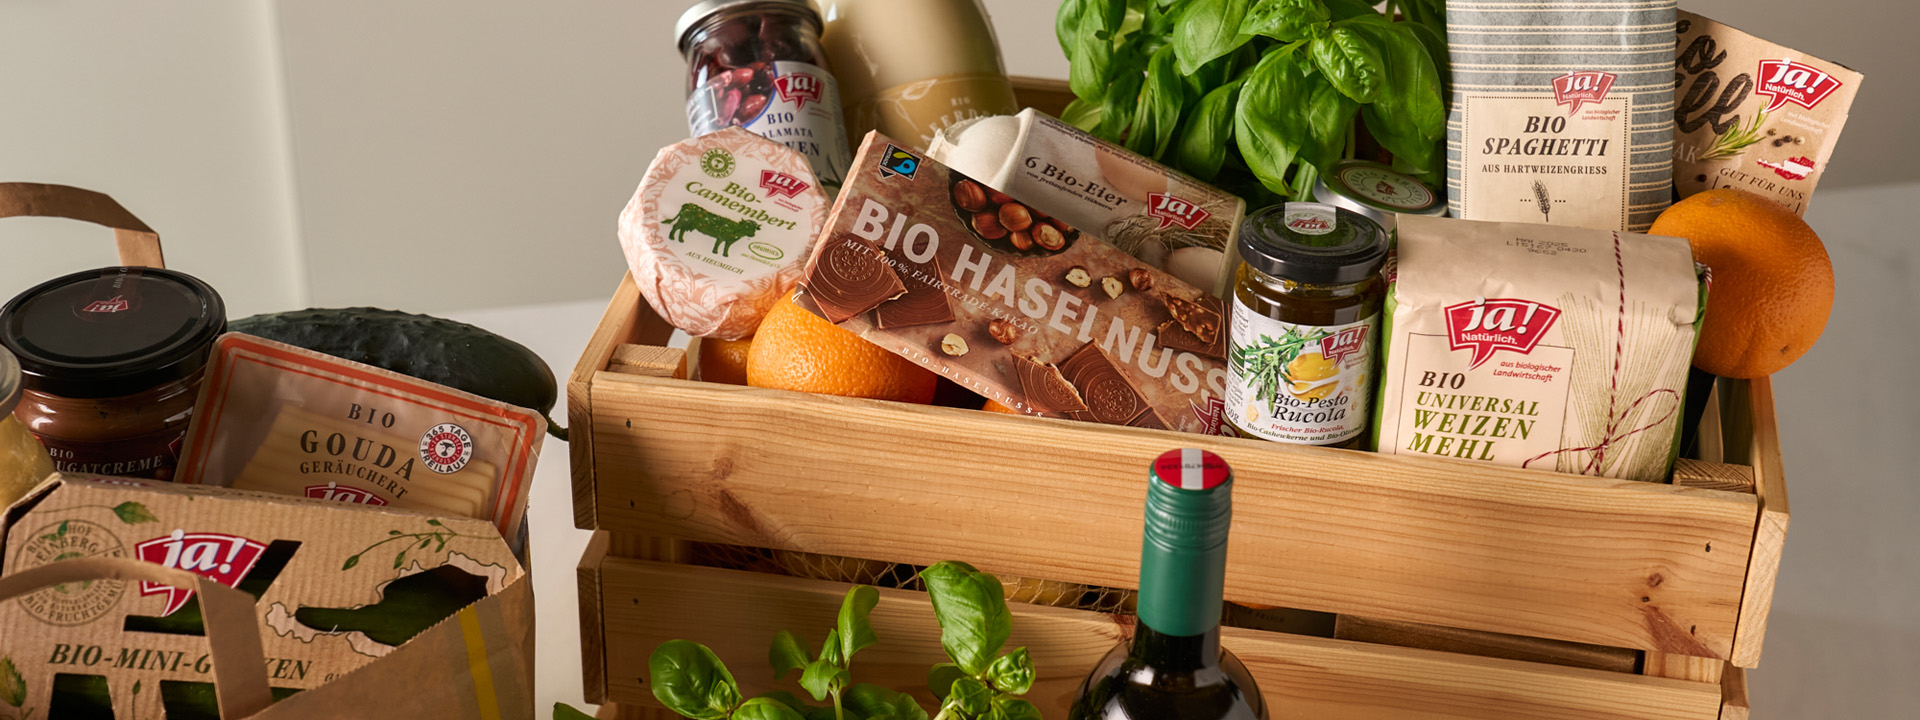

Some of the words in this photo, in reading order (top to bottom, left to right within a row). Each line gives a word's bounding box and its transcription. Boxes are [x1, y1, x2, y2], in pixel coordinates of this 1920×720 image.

[786, 72, 816, 92] ja!
[1563, 70, 1605, 93] ja!
[1767, 57, 1828, 94] ja!
[1765, 83, 1805, 101] Natürlich.
[767, 112, 794, 125] BIO
[1523, 115, 1567, 134] BIO
[762, 127, 813, 139] ALAMATA
[785, 141, 820, 156] VEN
[1482, 137, 1609, 157] SPAGHETTI
[767, 170, 802, 190] ja!
[1482, 164, 1500, 173] AUS
[1504, 165, 1607, 175] HARTWEIZENGRIESS
[722, 182, 762, 204] Bio-
[1025, 156, 1037, 169] 6
[1040, 163, 1128, 207] Bio-Eier
[1026, 171, 1039, 179] von
[1038, 175, 1083, 198] freilaufenden
[1720, 168, 1749, 182] GUT
[1749, 177, 1776, 192] FÜR
[1778, 186, 1805, 201] UNS
[685, 181, 797, 231] Camembert
[1156, 192, 1200, 220] ja!
[685, 251, 701, 260] AUS
[702, 256, 744, 275] HEUMILCH
[843, 239, 872, 256] MIT
[875, 253, 896, 268] 100
[897, 263, 909, 274] %
[911, 270, 1039, 335] FAIRTRADE-KAKAO
[852, 198, 940, 264] BIO
[951, 243, 1228, 406] HASELNUSS
[1461, 296, 1540, 334] ja!
[1329, 327, 1362, 350] ja!
[1461, 332, 1518, 344] Natürlich.
[1493, 369, 1553, 382] Landwirtschaft
[1515, 360, 1562, 373] biologischer
[1418, 371, 1466, 390] BIO
[1273, 393, 1349, 409] Bio-Pesto
[1416, 391, 1540, 416] UNIVERSAL
[347, 403, 395, 429] BIO
[1208, 406, 1221, 435] Natürlic
[1271, 404, 1346, 423] Rucola
[1414, 408, 1536, 440] WEIZEN
[426, 426, 444, 440] 365
[450, 426, 471, 448] TAGE
[1247, 422, 1308, 441] Bio-Cashewkerne
[1271, 423, 1303, 433] Frischer
[50, 447, 74, 460] BIO
[300, 429, 415, 481] GOUDA
[1406, 432, 1496, 461] MEHL
[56, 454, 163, 475] UGATCREME
[421, 448, 466, 472] FREILAUF
[300, 460, 408, 500] GERÄUCHERT
[68, 525, 93, 536] HOF
[162, 528, 247, 574] ja!
[24, 580, 123, 621] BIO-FRUCHTGEMÜ
[47, 643, 313, 682] BIO-MINI-GKEN
